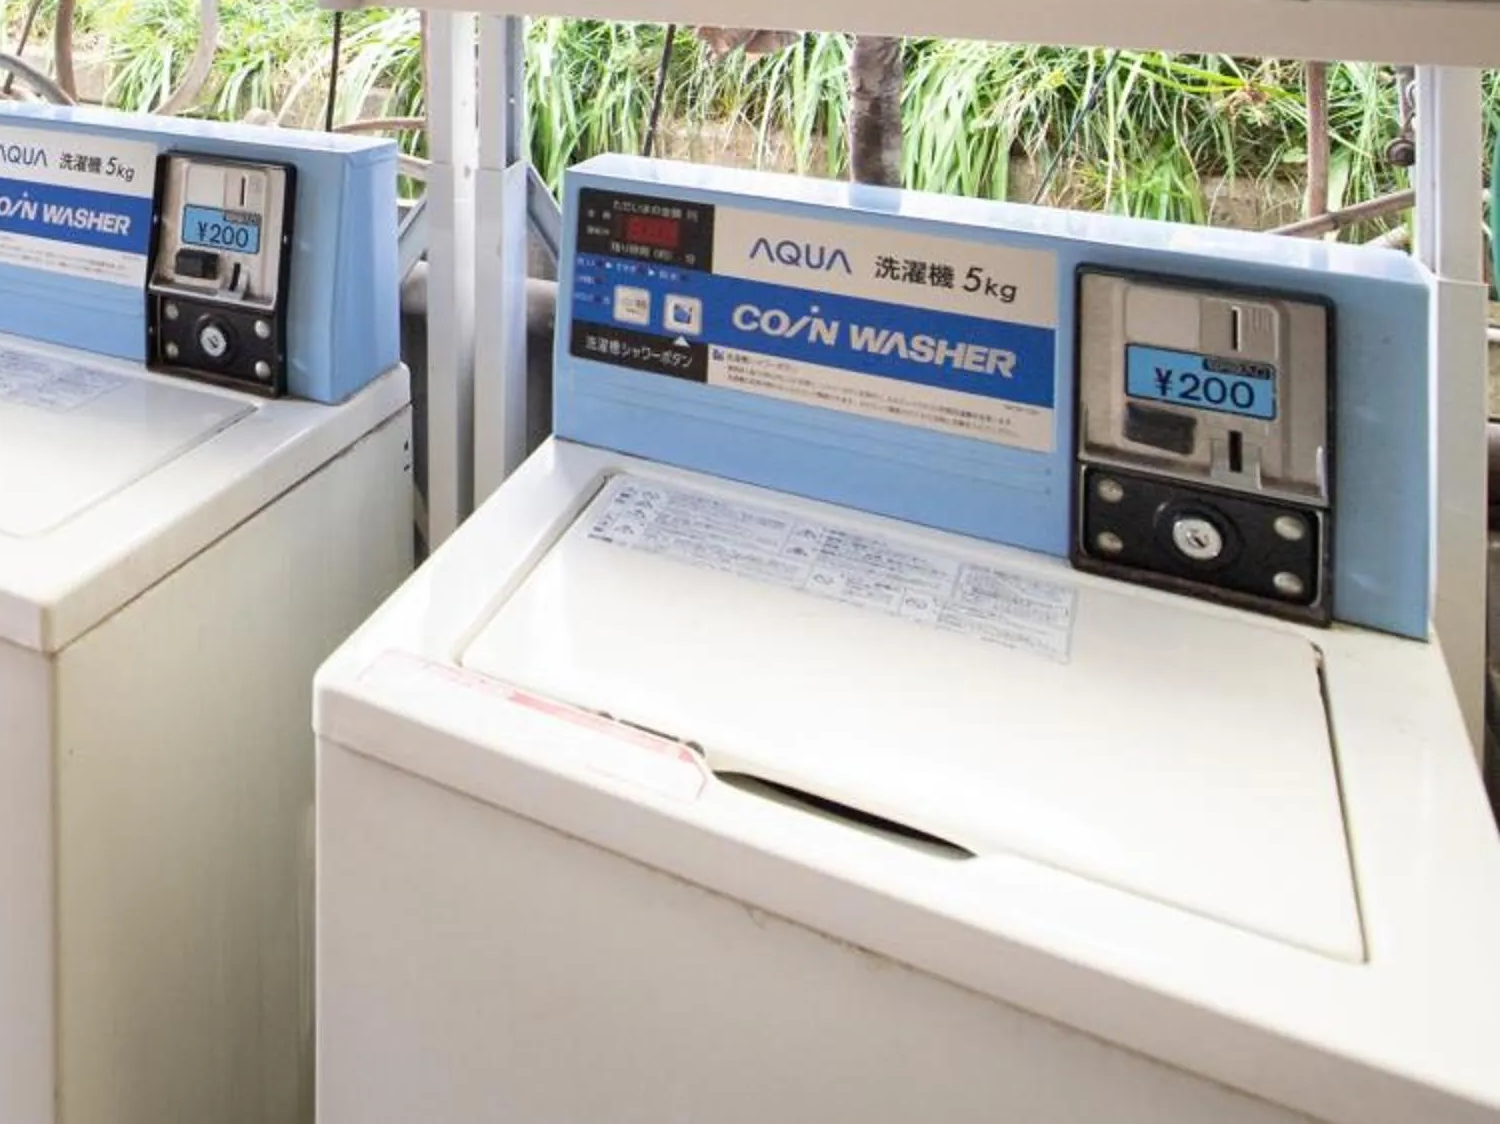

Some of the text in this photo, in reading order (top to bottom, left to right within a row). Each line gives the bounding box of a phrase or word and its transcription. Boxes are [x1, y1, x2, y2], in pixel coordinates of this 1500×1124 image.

[59, 151, 102, 173] 洗濯機
[105, 156, 135, 182] 5kg
[43, 203, 132, 236] WASHER
[197, 220, 249, 248] ¥200
[749, 237, 1018, 303] AQUA 洗濯機 5kg
[732, 304, 1017, 378] COIN WASHER
[1154, 366, 1256, 410] ¥200
